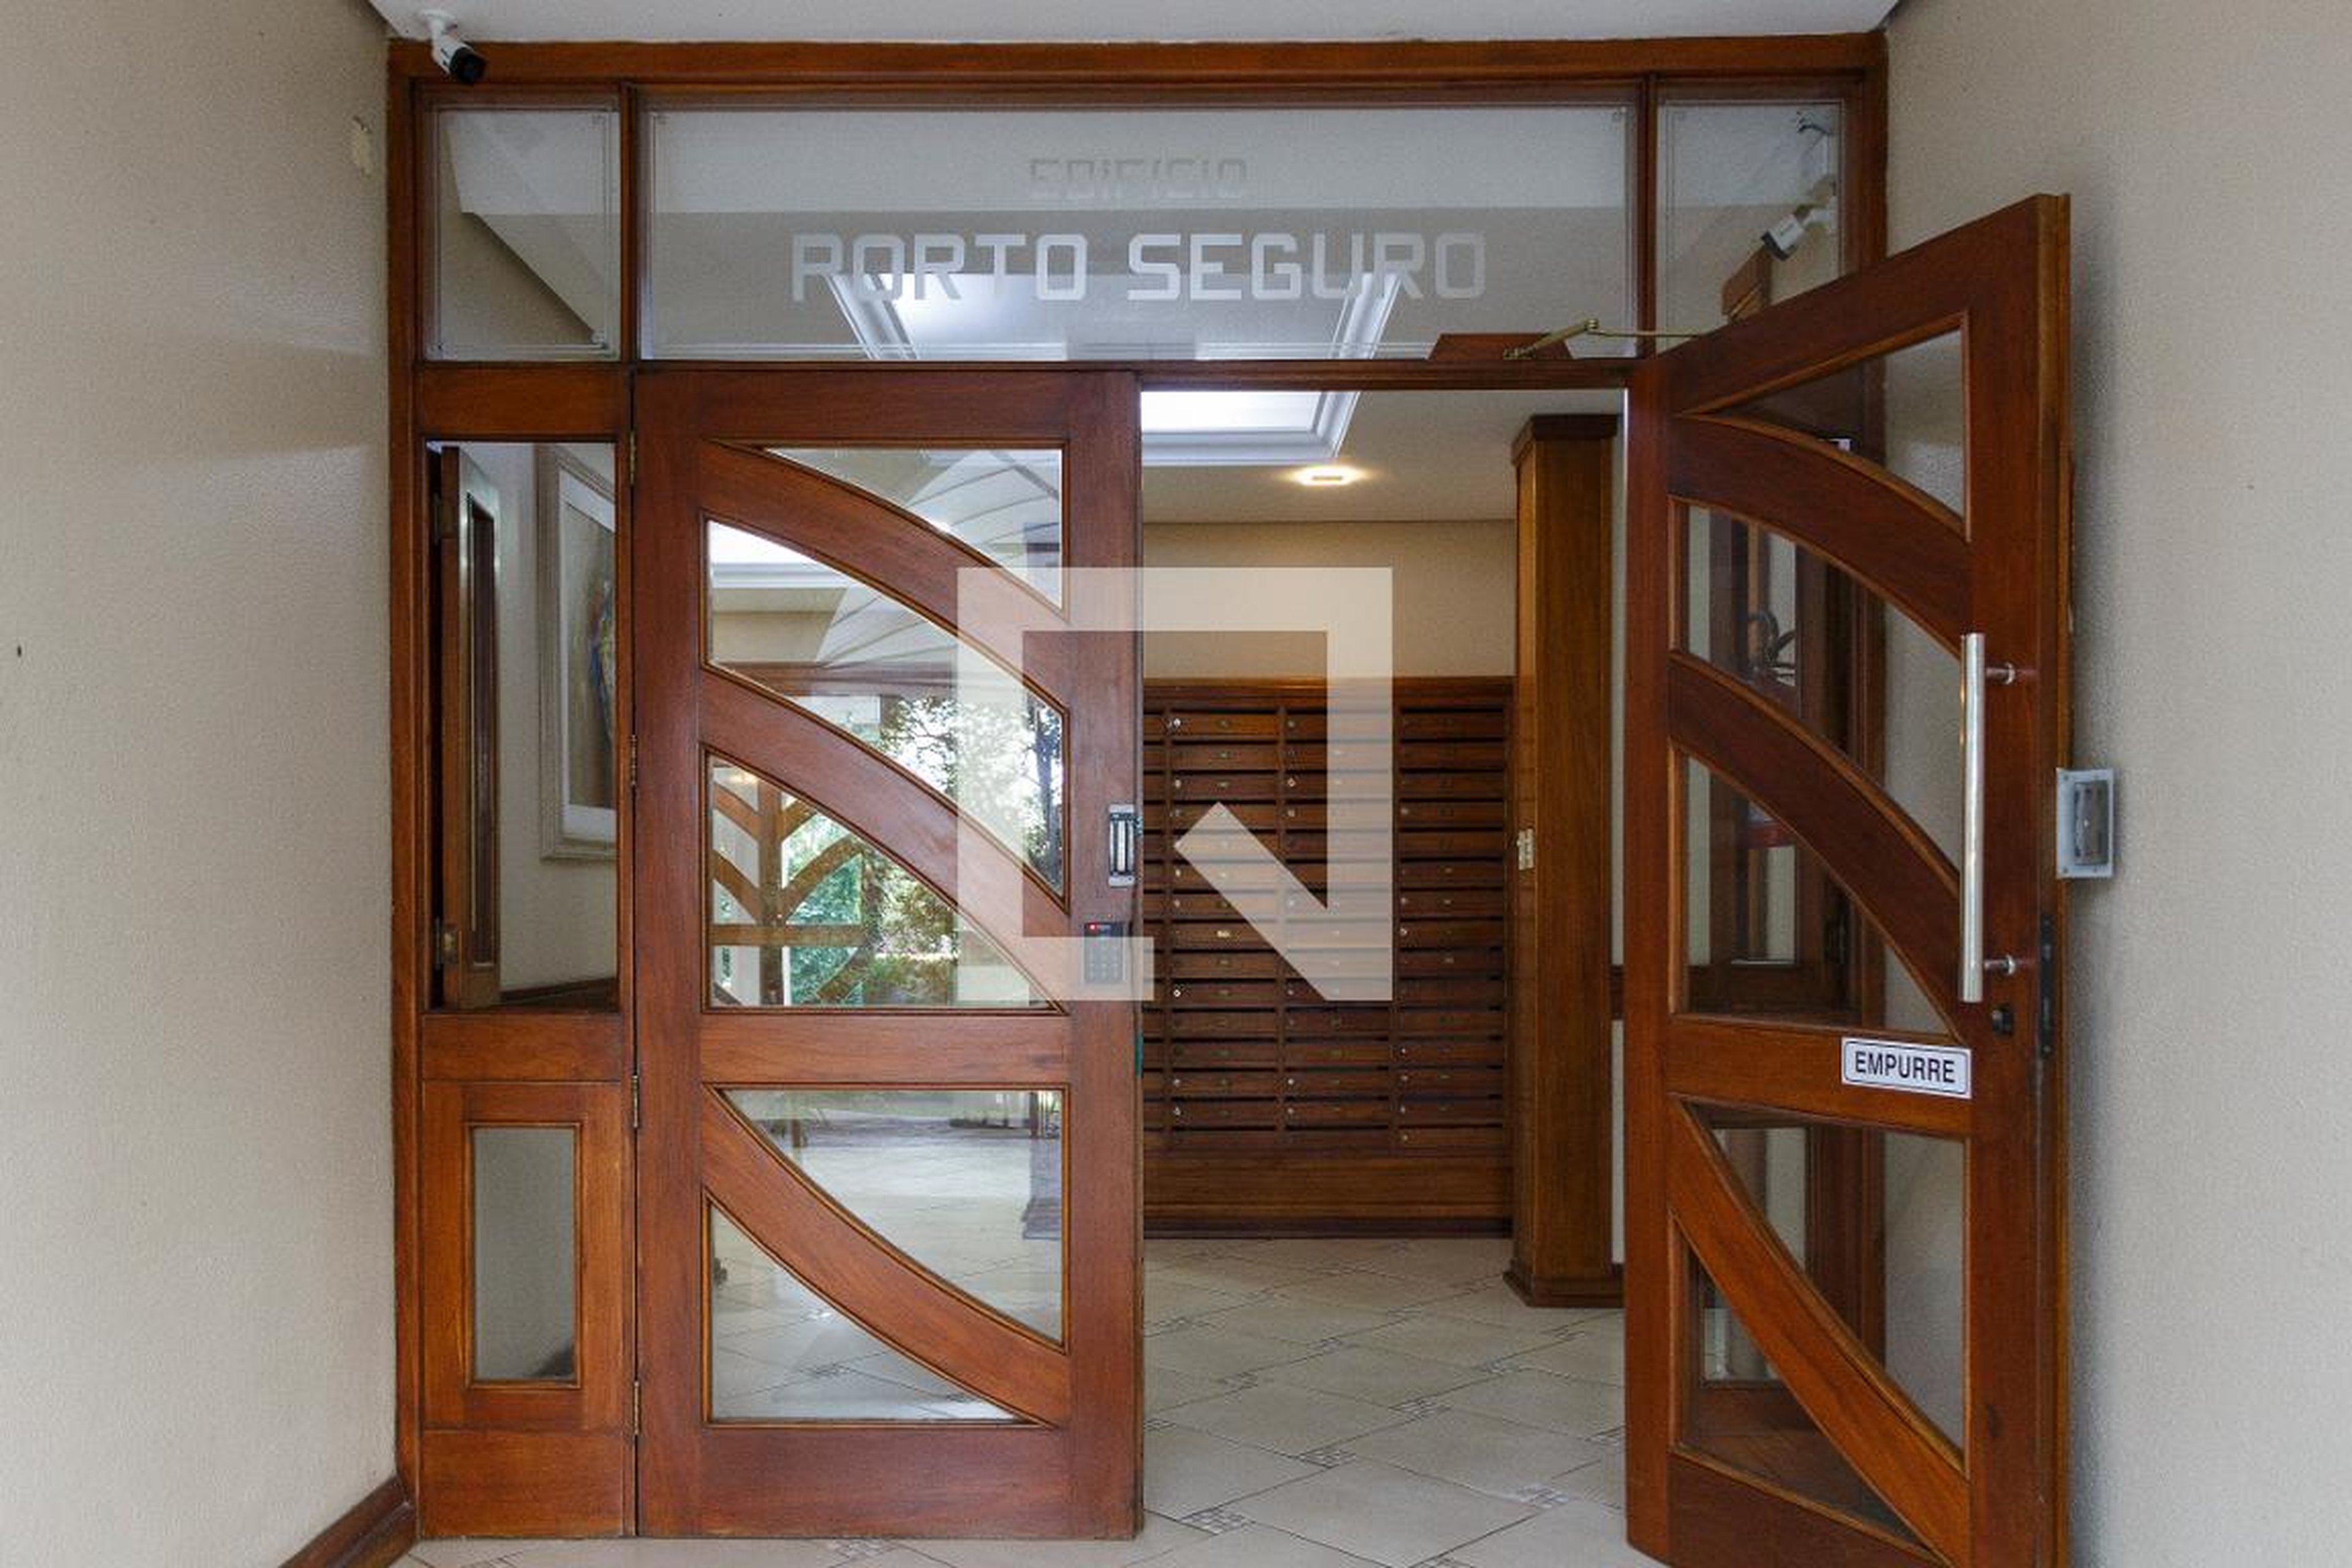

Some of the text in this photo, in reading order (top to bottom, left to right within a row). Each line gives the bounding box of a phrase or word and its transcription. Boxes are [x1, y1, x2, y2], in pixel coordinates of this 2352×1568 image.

[791, 233, 1486, 301] PORTO SEGURO
[1855, 1051, 1956, 1084] EMPURRE
